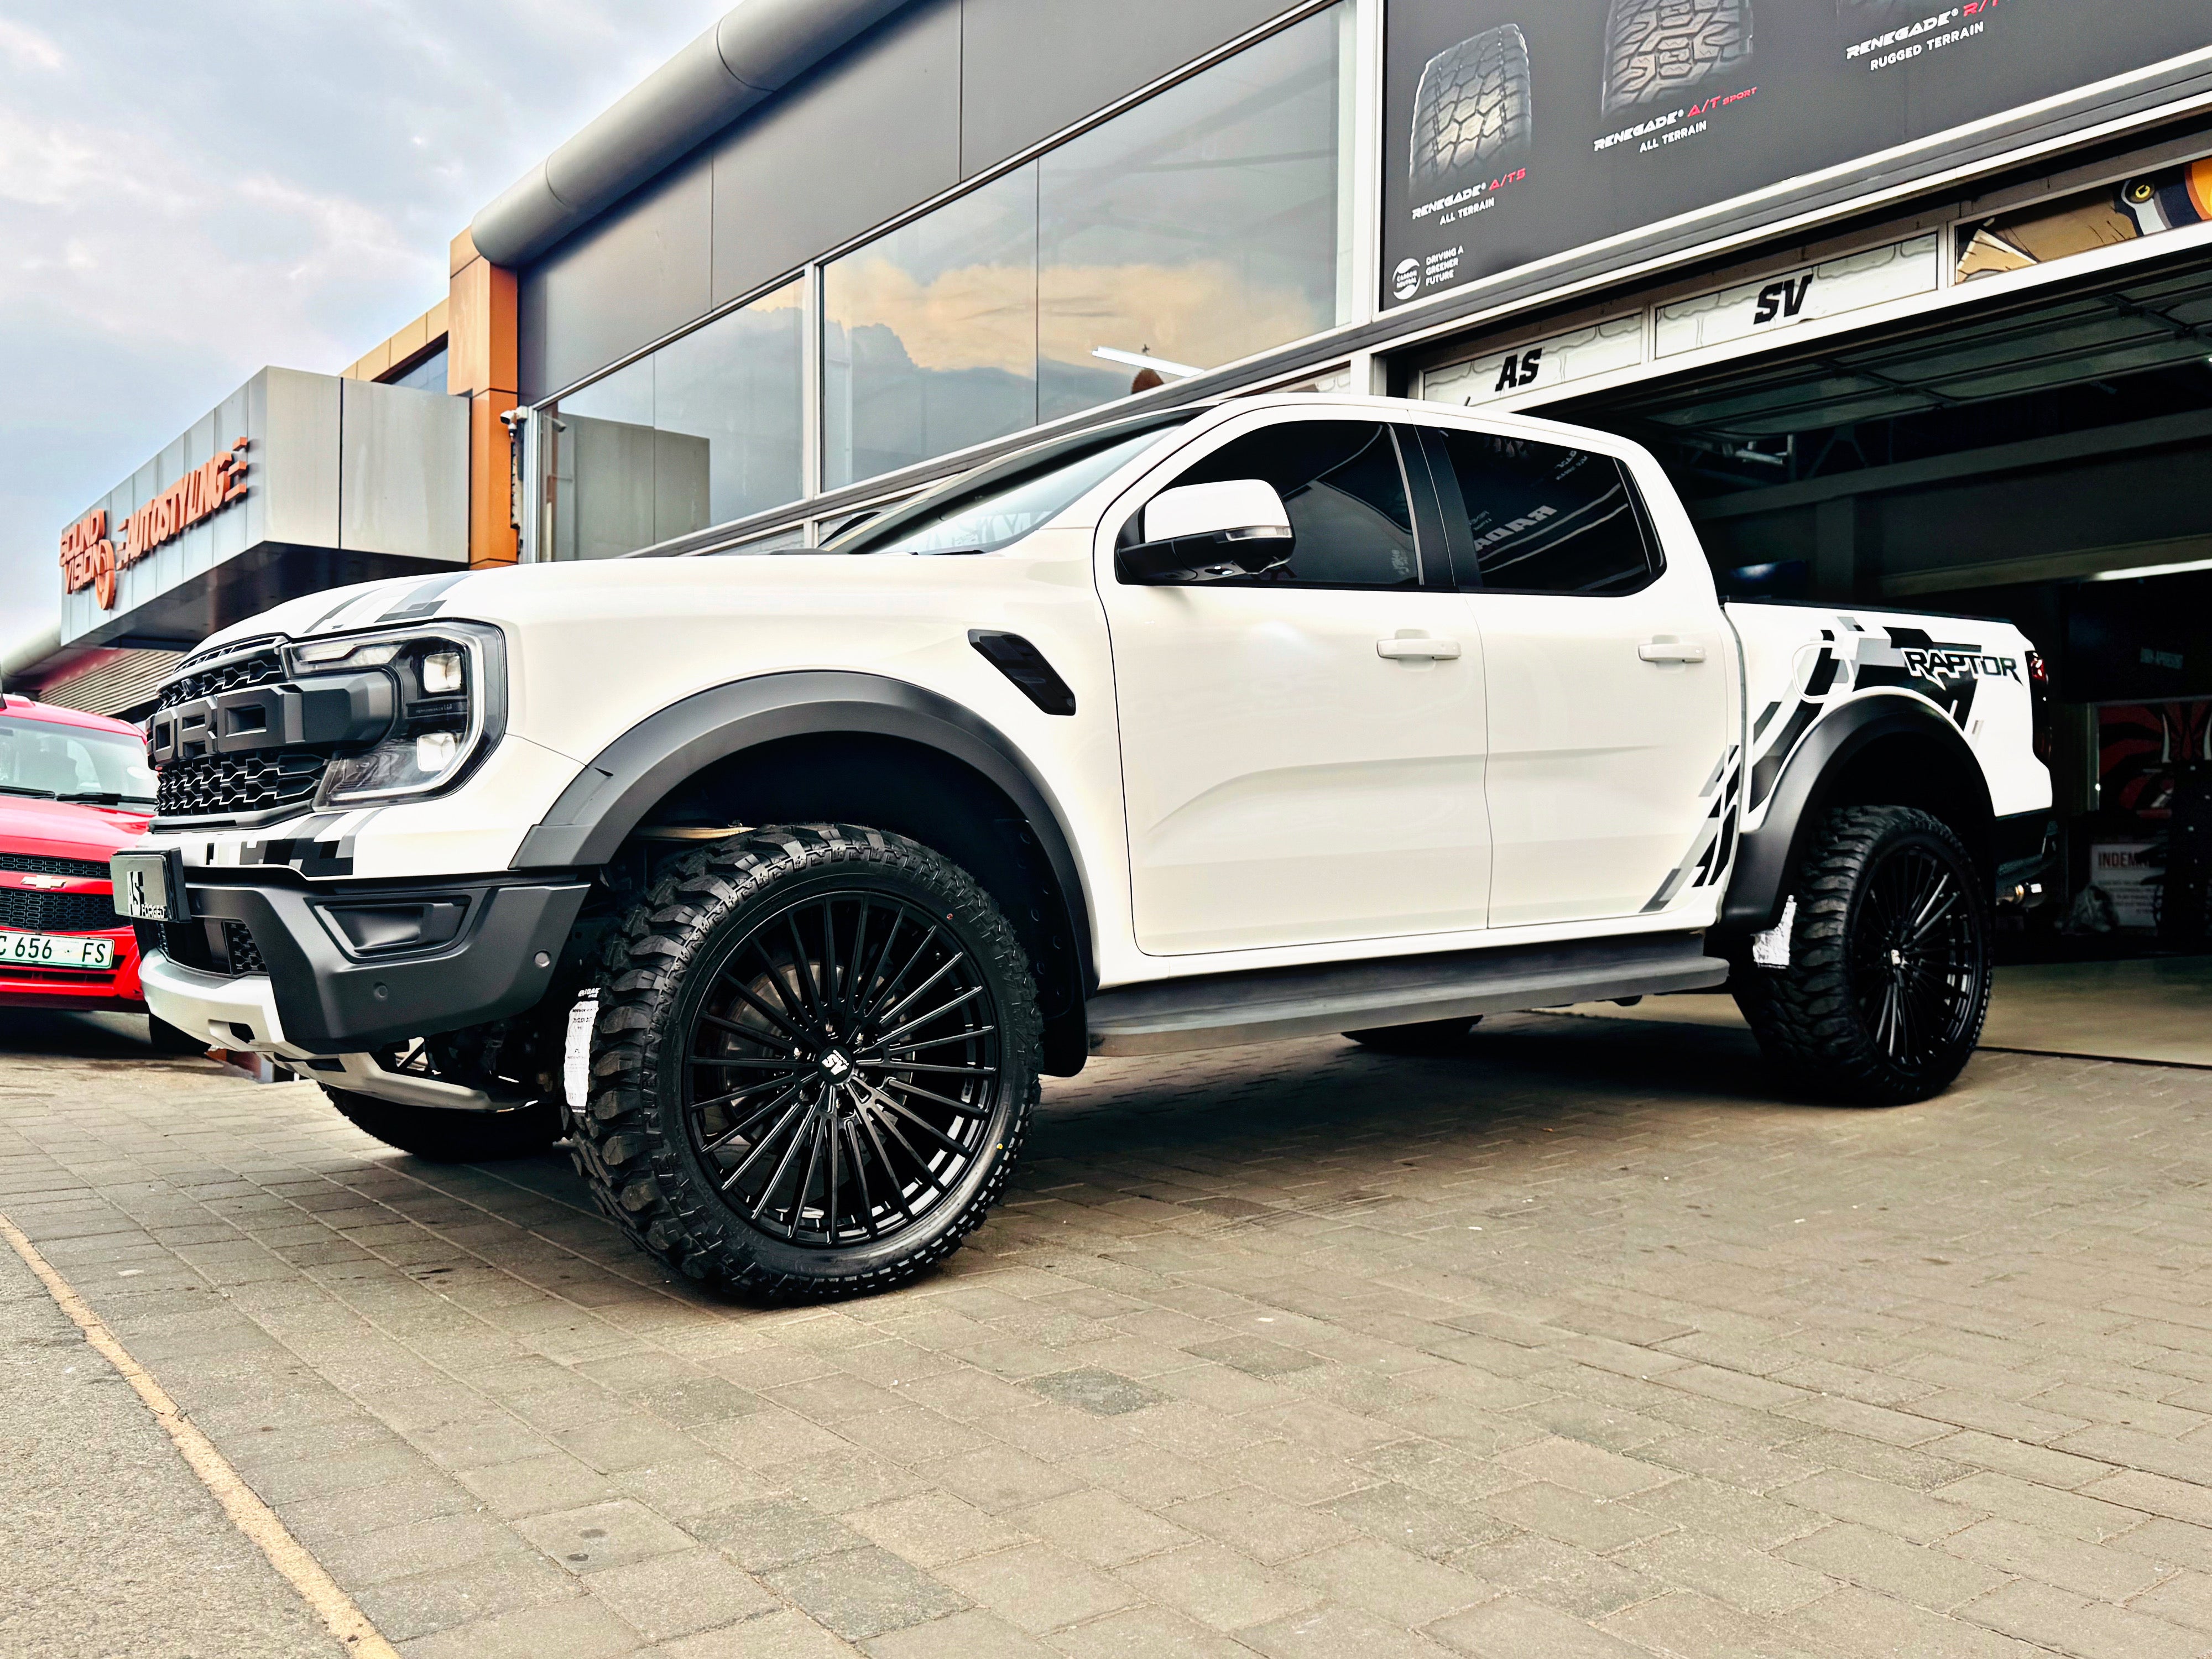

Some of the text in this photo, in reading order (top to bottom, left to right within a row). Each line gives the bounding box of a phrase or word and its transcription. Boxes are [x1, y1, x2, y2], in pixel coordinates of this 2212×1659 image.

[1963, 0, 1999, 17] R/
[1870, 20, 1984, 71] RUGGED TERRAIN
[1687, 95, 1721, 118] A/T
[1722, 86, 1757, 106] SPORT
[1639, 119, 1707, 153] ALL TERRAIN
[1439, 196, 1495, 226] ALL TERRAIN
[1425, 257, 1459, 276] GREENER
[1426, 244, 1464, 266] DRIVING A
[1425, 269, 1455, 286] FUTURE
[1752, 273, 1814, 325] SV
[1494, 347, 1542, 392] AS
[124, 451, 233, 560] AUTOSTYLING
[60, 508, 106, 567] SOUND
[64, 543, 101, 595] VISION
[1902, 648, 2025, 690] RAPTOR
[14, 937, 53, 959] 656
[82, 942, 106, 963] FS
